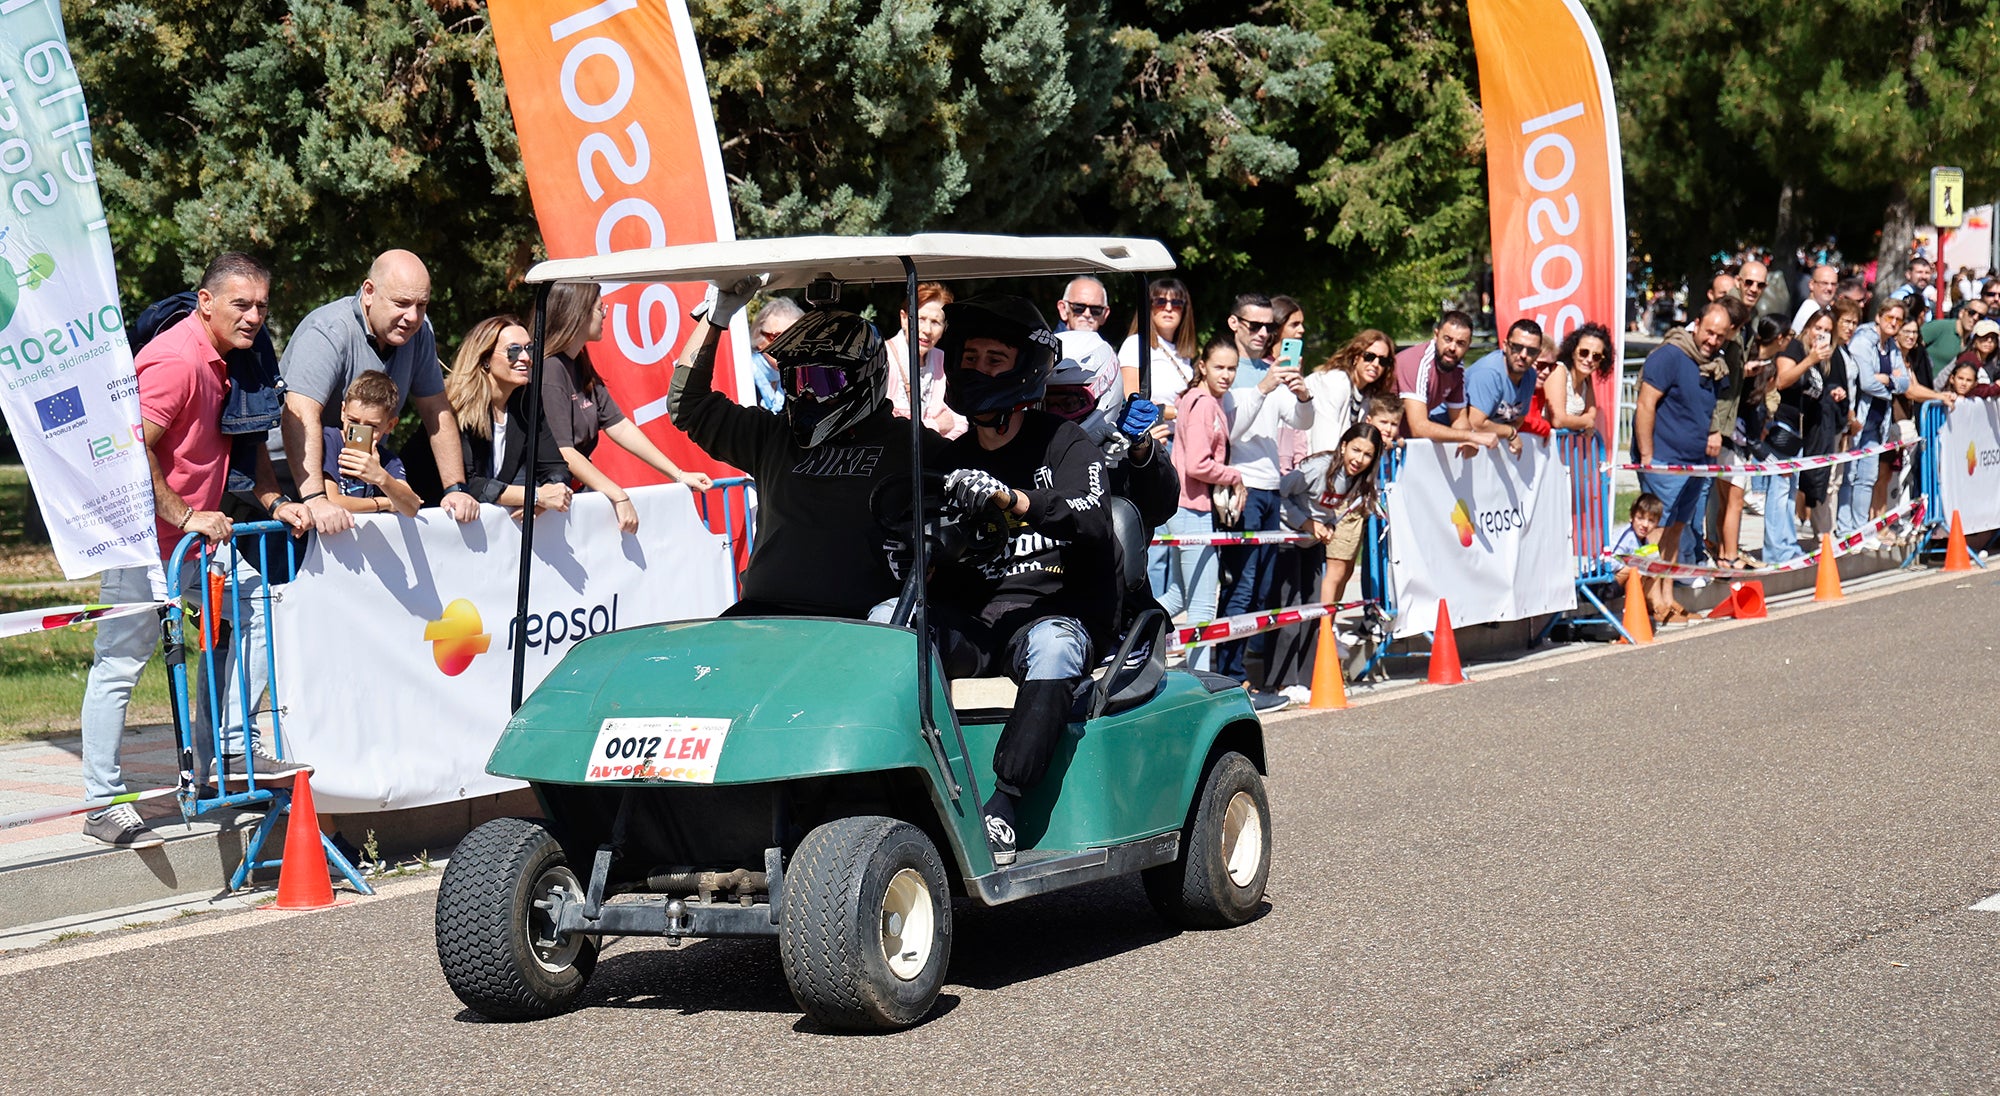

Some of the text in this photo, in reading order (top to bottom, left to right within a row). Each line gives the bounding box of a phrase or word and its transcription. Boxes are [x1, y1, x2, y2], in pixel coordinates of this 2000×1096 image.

[792, 445, 884, 477] NIKE
[1480, 501, 1527, 538] repsol
[507, 593, 618, 655] repsol
[605, 737, 711, 760] 0012 LEN
